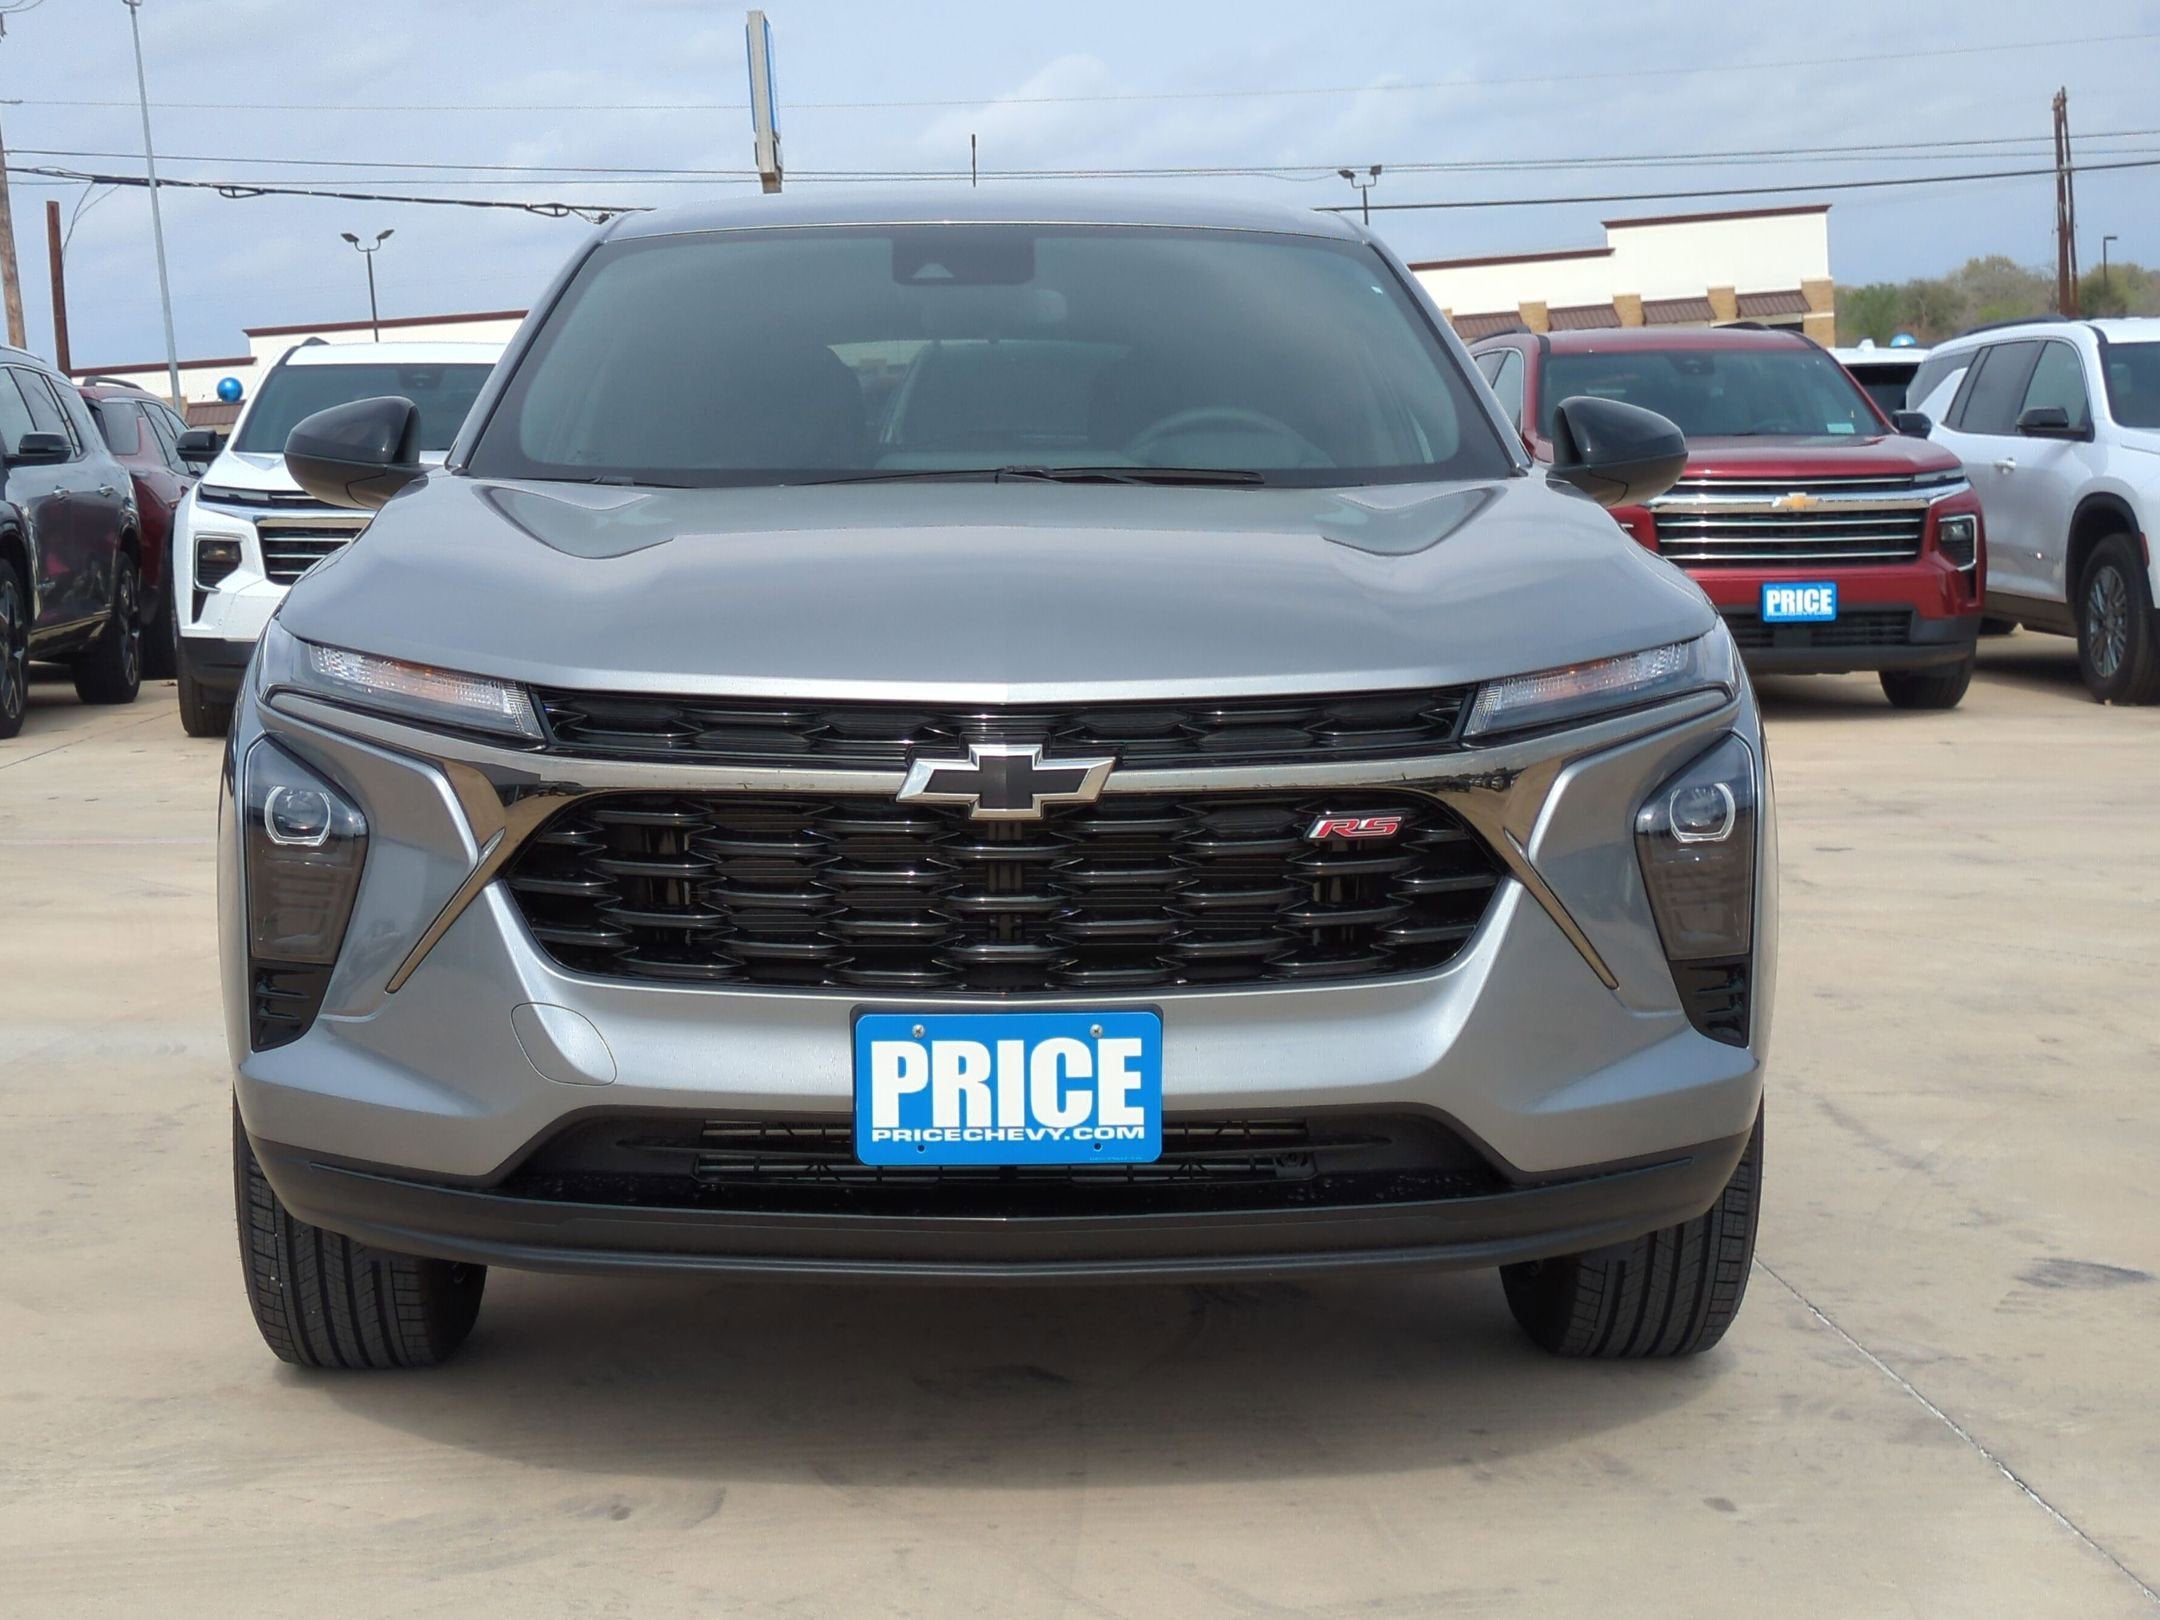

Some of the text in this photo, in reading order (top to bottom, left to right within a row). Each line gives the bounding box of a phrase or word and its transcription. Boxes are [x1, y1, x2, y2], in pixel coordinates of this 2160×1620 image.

[1766, 588, 1833, 614] PRICE
[1308, 816, 1402, 838] RS
[871, 1037, 1144, 1128] PRICE
[871, 1126, 1144, 1142] PRICECHEVY.COM
